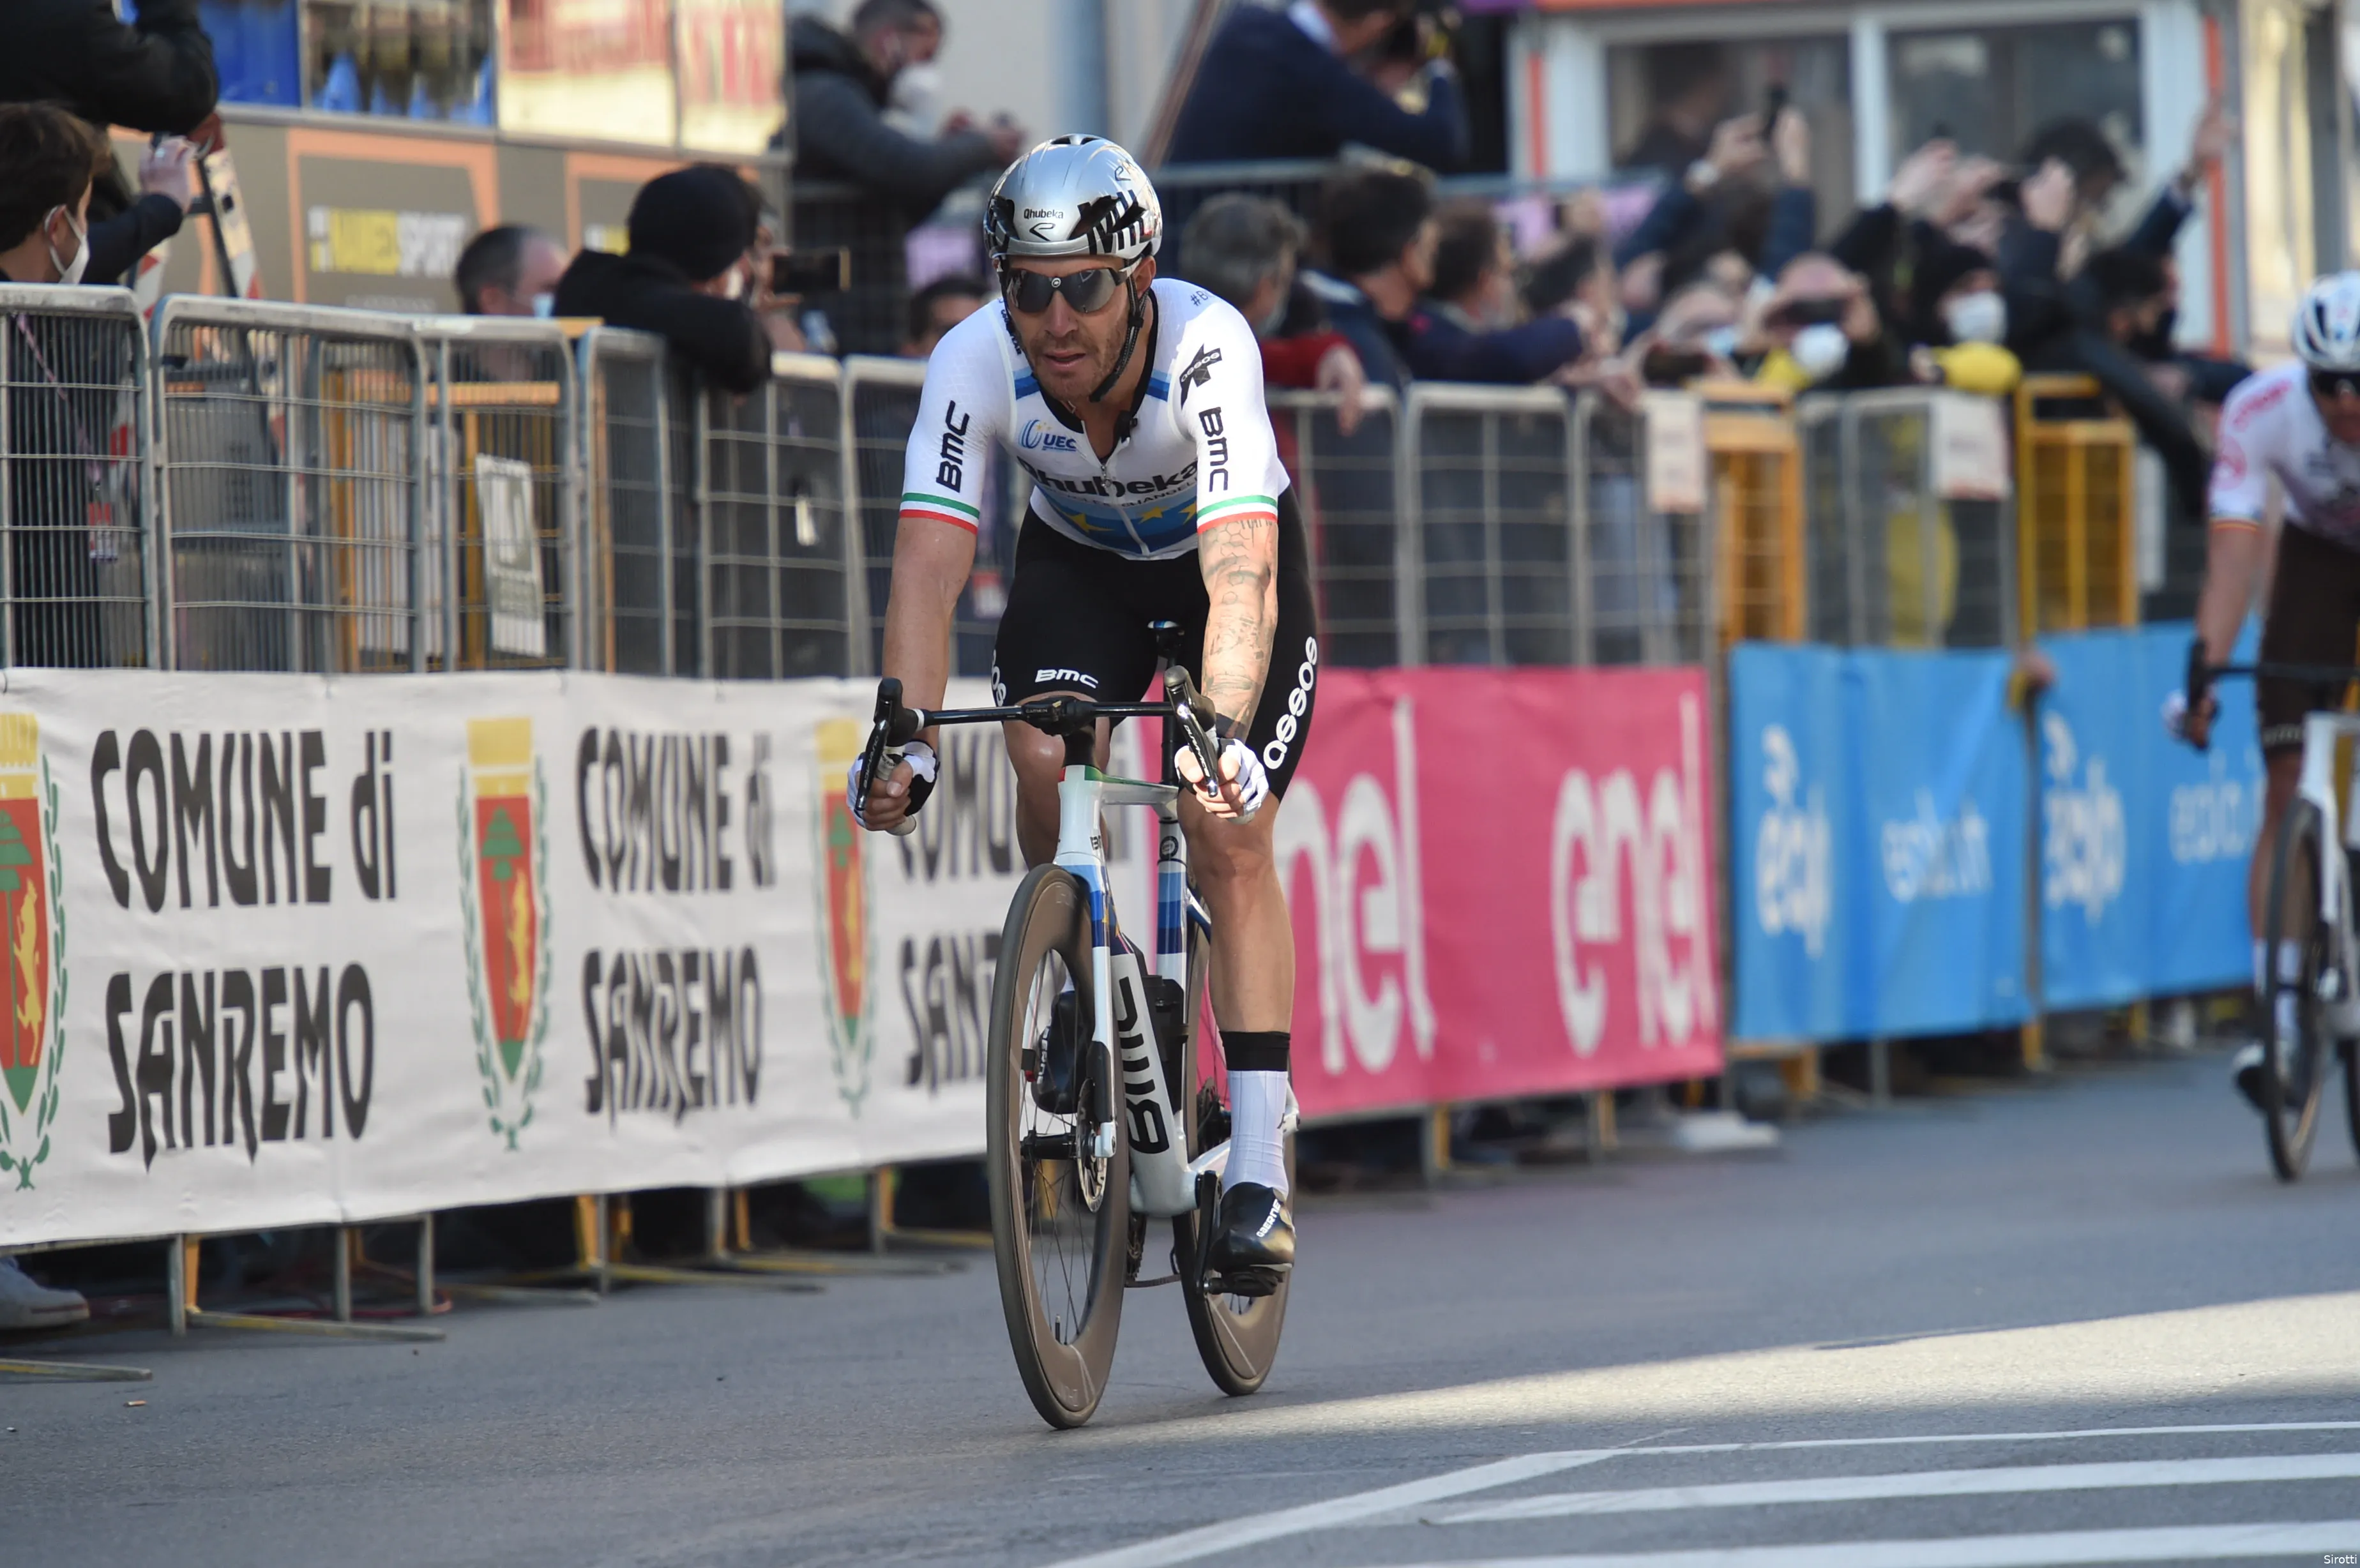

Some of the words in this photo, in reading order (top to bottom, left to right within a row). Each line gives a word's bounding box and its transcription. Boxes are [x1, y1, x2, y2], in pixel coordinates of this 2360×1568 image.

[1024, 208, 1063, 219] Qhubeka
[935, 400, 970, 494] BMC
[1043, 433, 1077, 449] UEC
[1199, 407, 1229, 493] BMC
[1034, 669, 1098, 689] BMC
[1263, 636, 1317, 769] assos
[91, 727, 331, 913] COMUNE
[350, 728, 397, 901] di
[577, 726, 734, 893] COMUNE
[746, 732, 777, 888] di
[1273, 694, 1437, 1075] nel
[1550, 690, 1718, 1057] enel
[105, 961, 375, 1174] SANREMO
[582, 945, 762, 1135] SANREMO
